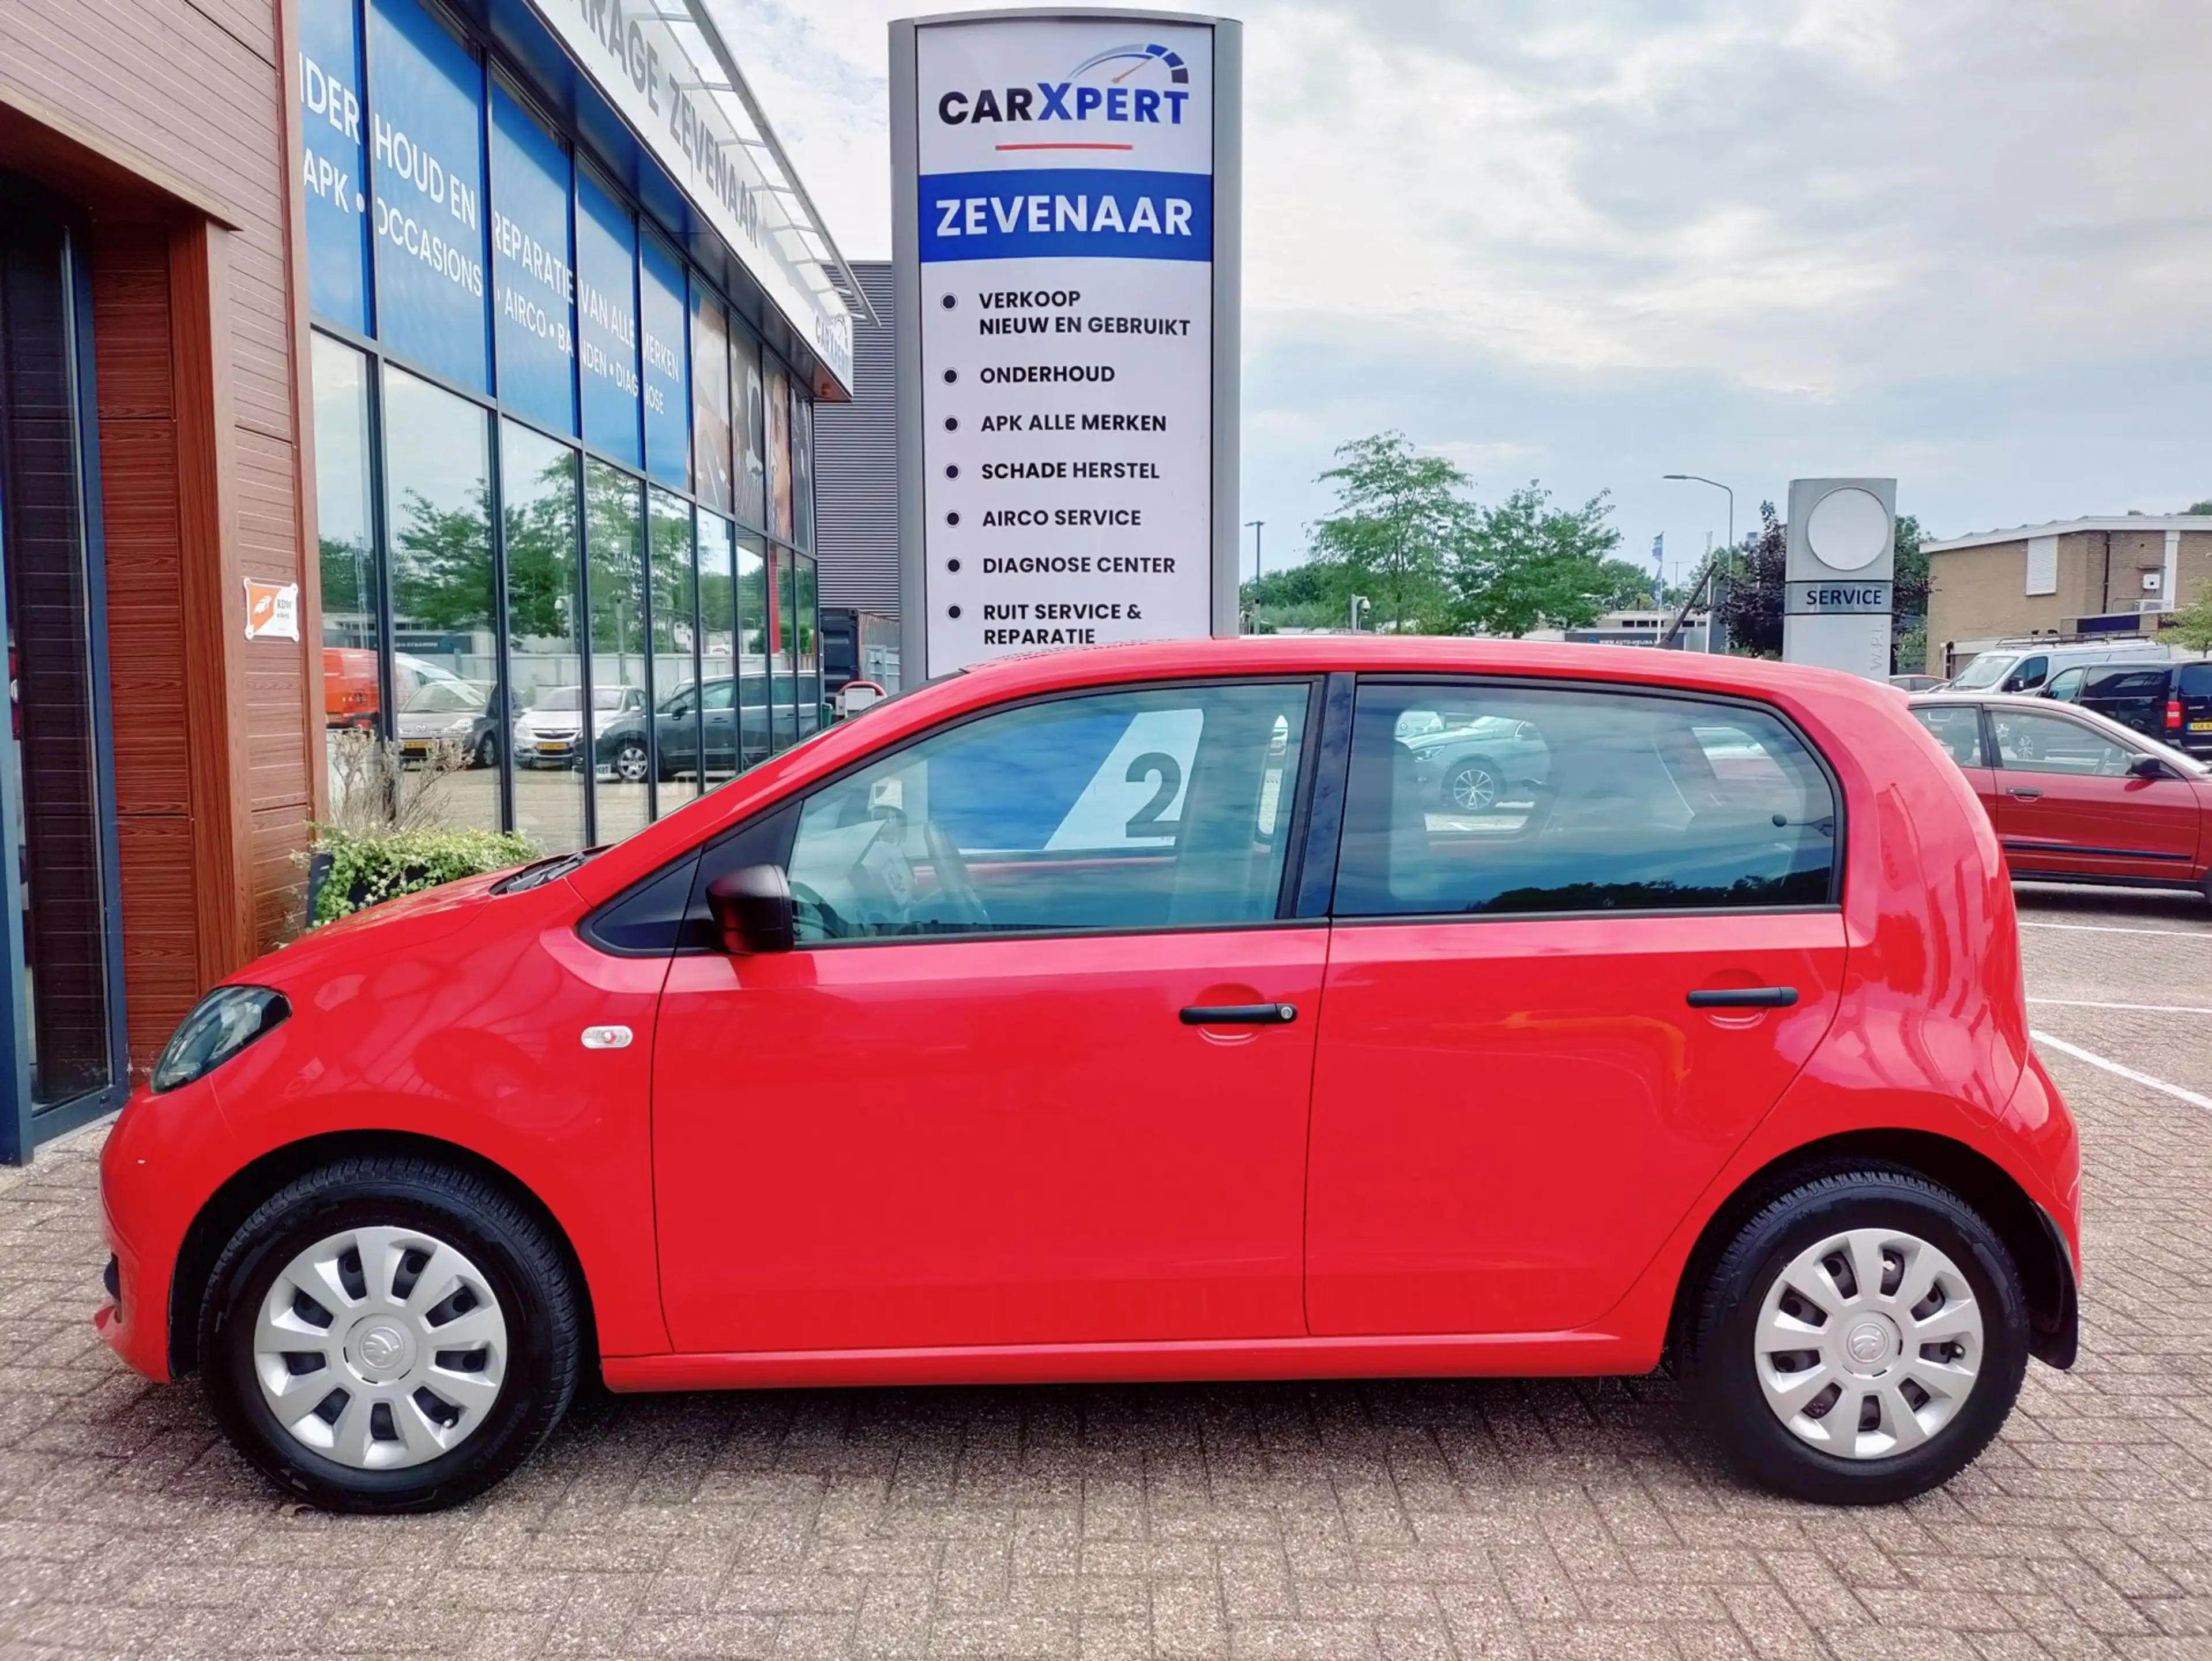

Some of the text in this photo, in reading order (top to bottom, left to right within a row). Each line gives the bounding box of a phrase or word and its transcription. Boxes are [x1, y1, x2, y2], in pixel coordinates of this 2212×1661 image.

[938, 82, 1190, 126] CARXPERT
[580, 0, 758, 249] RAGE ZEVENAAR
[299, 51, 360, 145] DER
[450, 174, 475, 231] EN
[579, 278, 608, 329] VAN
[611, 304, 635, 351] ALLE
[936, 194, 1192, 237] ZEVENAAR
[303, 148, 349, 213] APK
[505, 287, 546, 338] AIRCO
[979, 291, 1081, 309] VERKOOP
[980, 317, 1191, 336] NIEUW EN GEBRUIKT
[980, 366, 1116, 384] ONDERHOUD
[981, 414, 1167, 432] APK ALLE MERKEN
[981, 462, 1160, 480] SCHADE HERSTEL
[983, 509, 1142, 527] AIRCO SERVICE
[983, 557, 1176, 573] DIAGNOSE CENTER
[1806, 589, 1882, 605] SERVICE
[984, 604, 1142, 620] RUIT SERVICE &
[984, 629, 1096, 645] REPARATIE
[1126, 751, 1181, 838] 2
